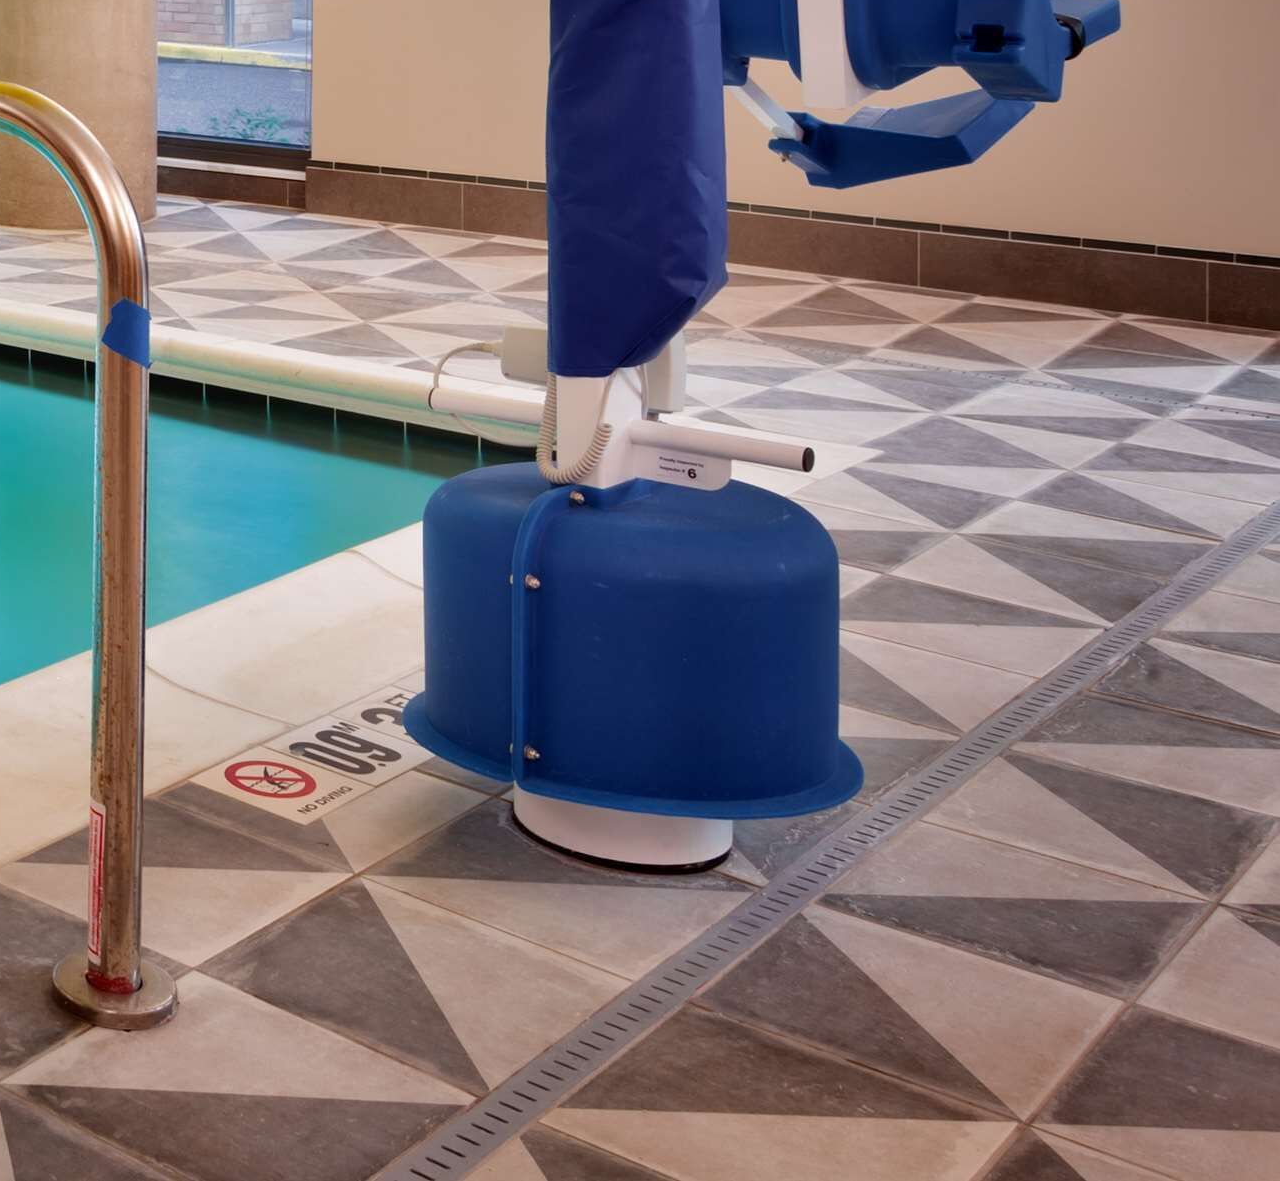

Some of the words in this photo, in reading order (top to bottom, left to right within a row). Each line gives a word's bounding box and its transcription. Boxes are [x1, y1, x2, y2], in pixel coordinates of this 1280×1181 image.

[687, 468, 697, 479] 6
[296, 803, 319, 815] NO
[313, 785, 354, 806] DIVING
